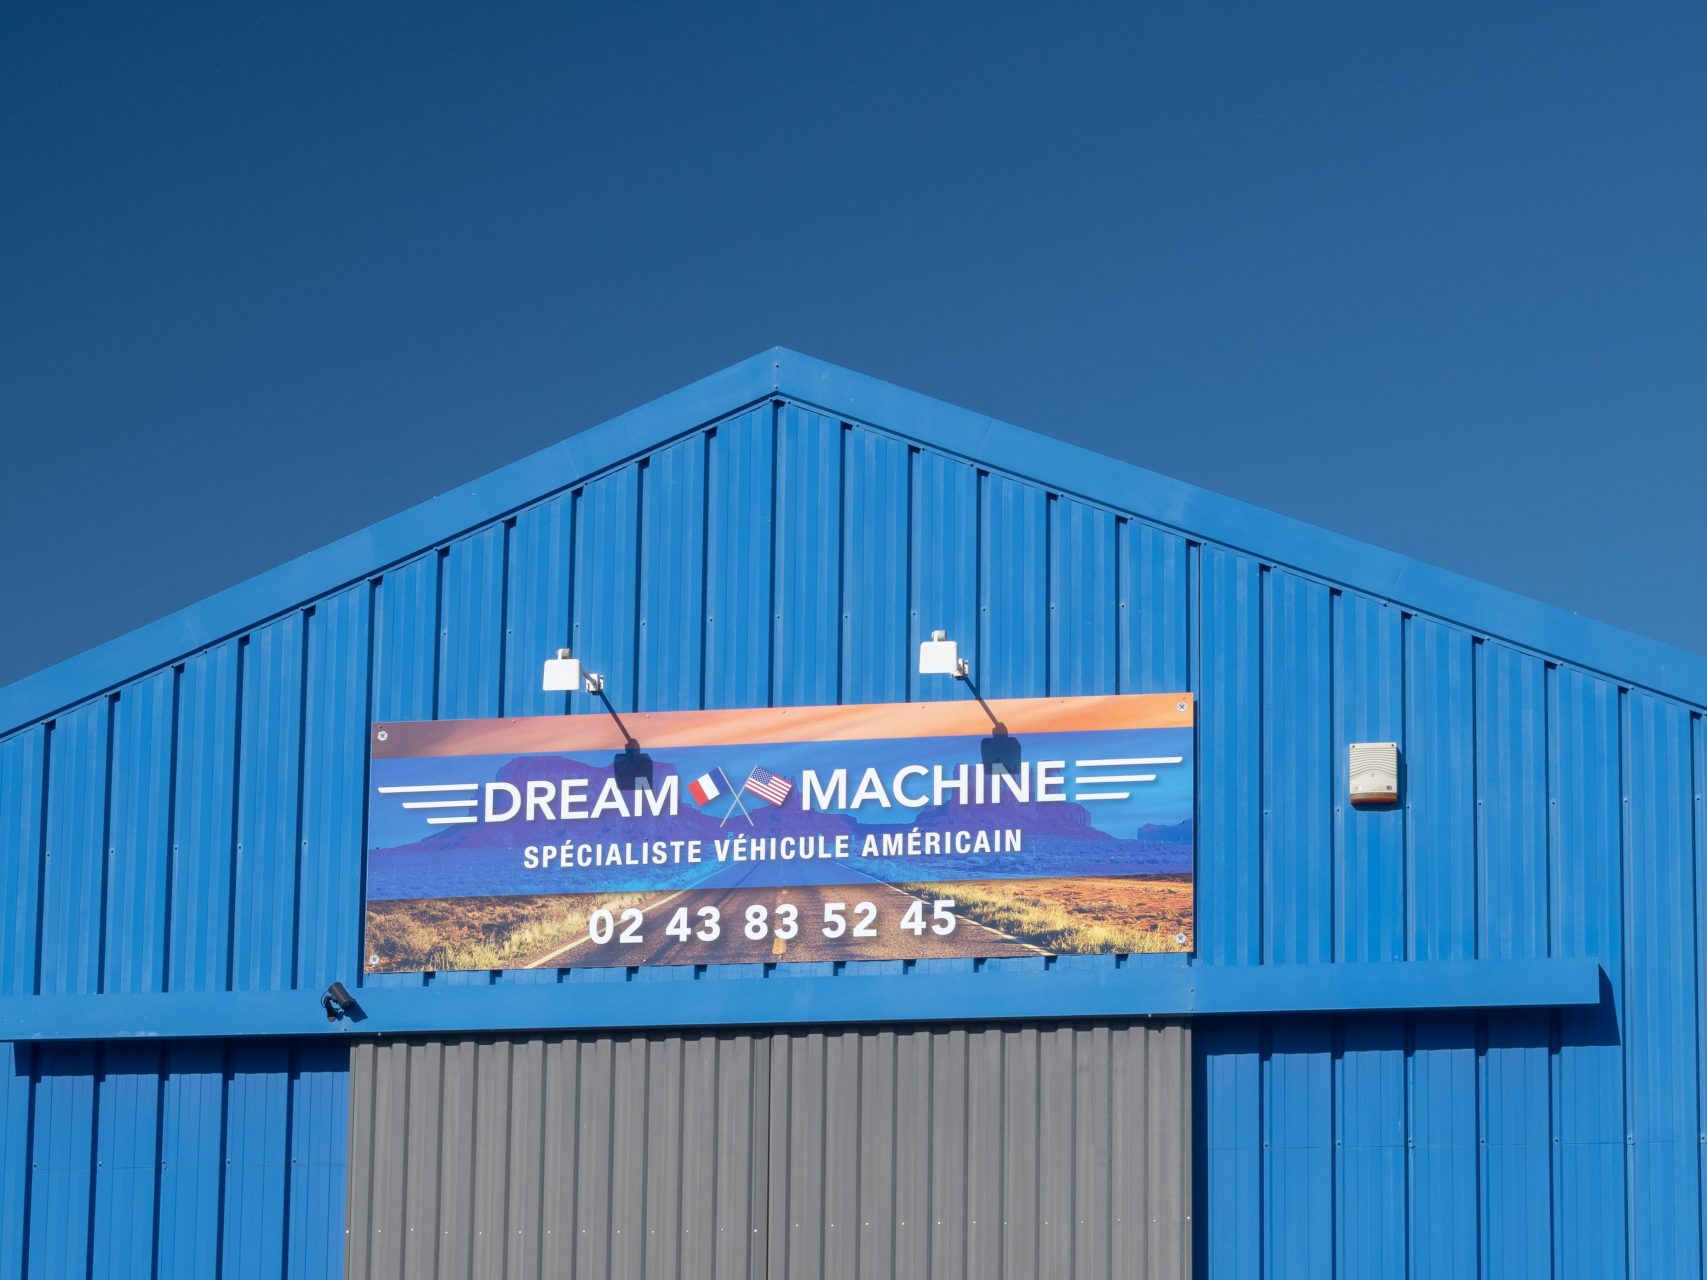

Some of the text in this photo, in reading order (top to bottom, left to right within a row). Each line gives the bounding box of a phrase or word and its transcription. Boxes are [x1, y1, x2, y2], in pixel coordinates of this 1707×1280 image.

[484, 760, 1067, 823] DREAM MACHINE
[523, 828, 1021, 869] SPÉCIALISTE VÉHICULE AMÉRICAIN
[588, 899, 957, 945] 02 43 83 52 45
